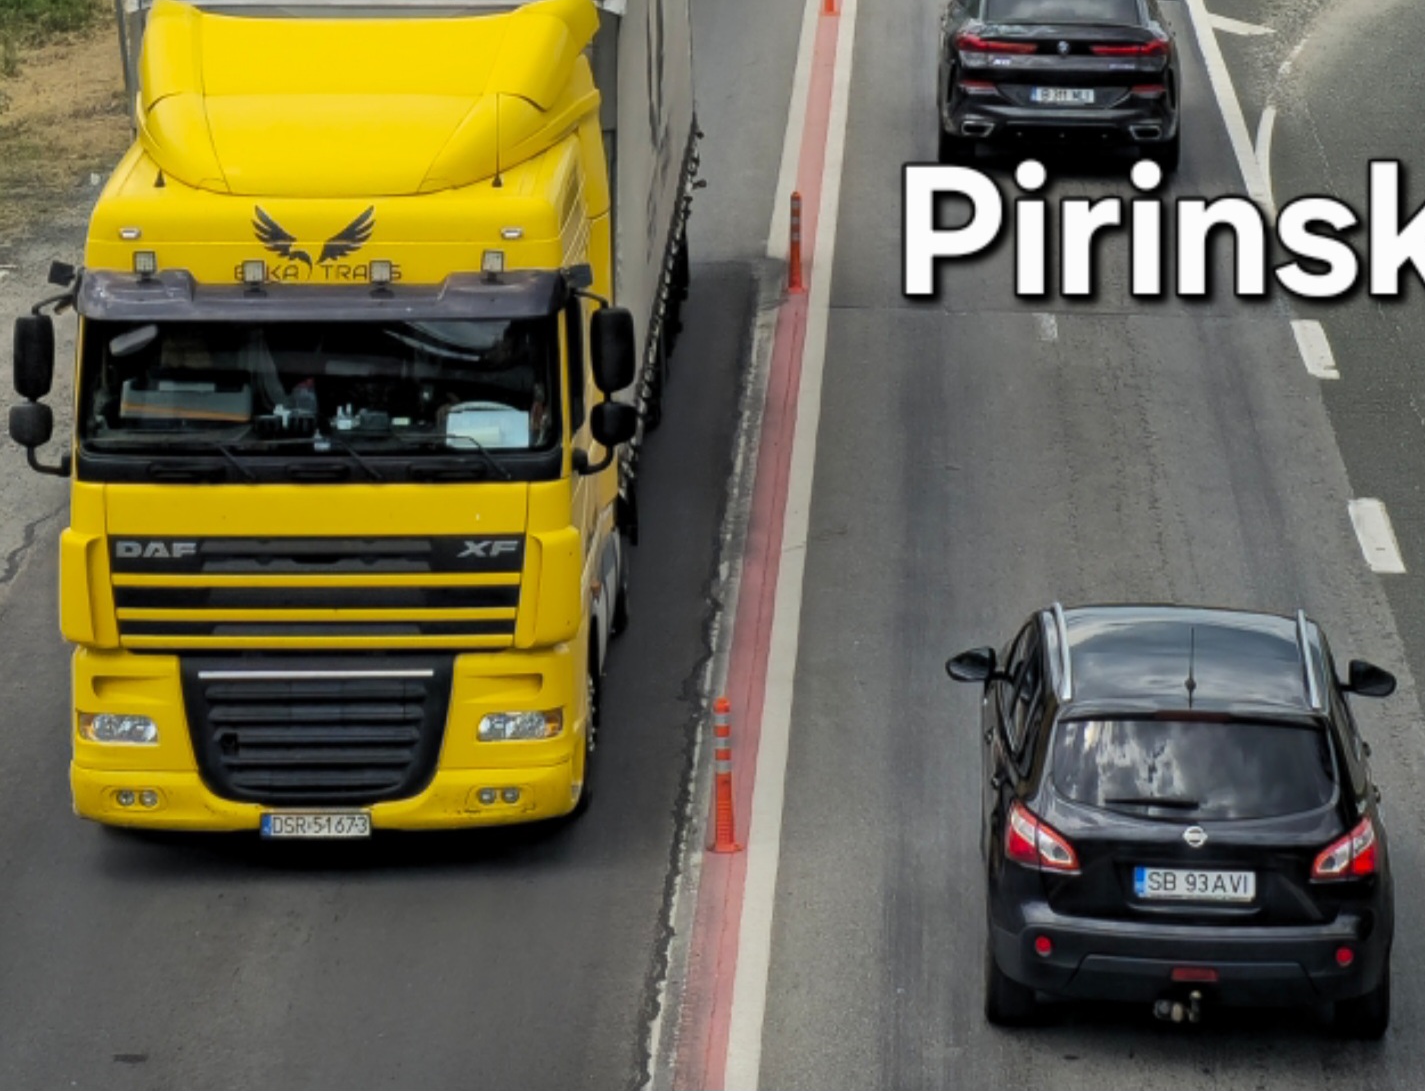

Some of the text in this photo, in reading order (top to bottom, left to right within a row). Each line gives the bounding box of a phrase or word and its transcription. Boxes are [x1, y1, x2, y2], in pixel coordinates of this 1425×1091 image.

[320, 265, 402, 280] TRAS
[116, 541, 196, 558] DAF
[458, 541, 518, 557] XF
[1148, 872, 1176, 891] SB
